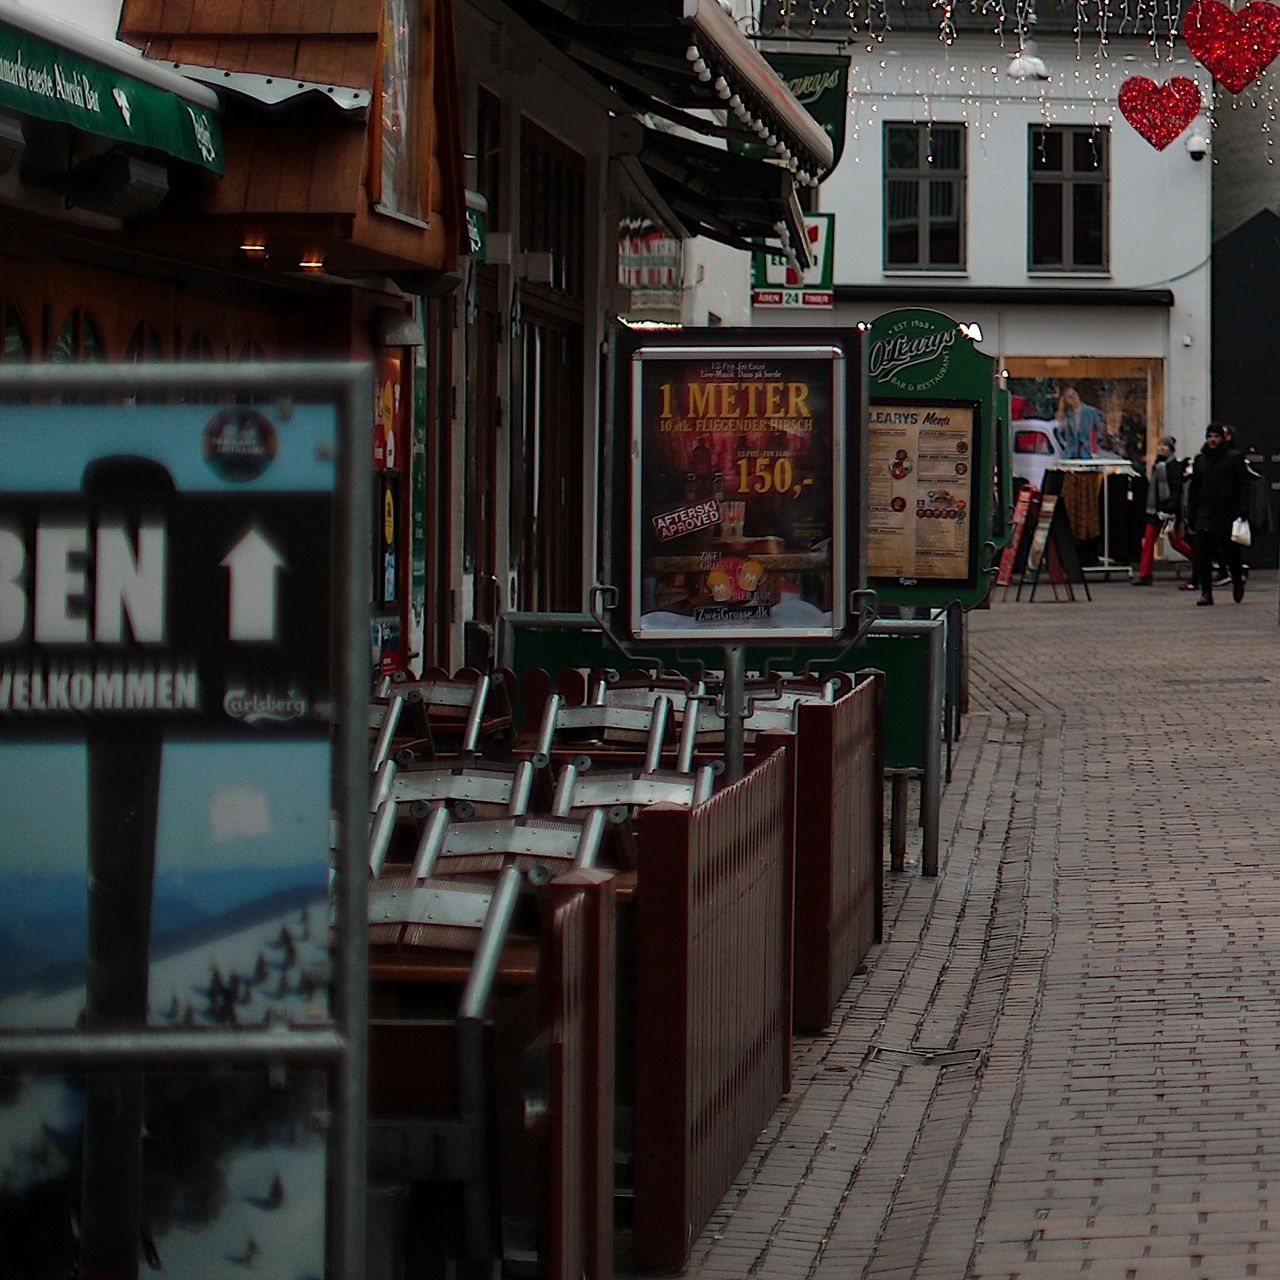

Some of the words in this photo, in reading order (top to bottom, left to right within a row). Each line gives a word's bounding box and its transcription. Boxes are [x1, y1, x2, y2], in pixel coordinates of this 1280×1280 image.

[785, 292, 799, 305] 24
[893, 321, 907, 332] EST
[891, 377, 906, 390] BAR
[916, 350, 951, 391] RESTAURANT
[659, 383, 673, 418] 1
[687, 382, 812, 418] METER
[659, 421, 673, 433] 10
[696, 420, 769, 433] FLIEGENDER
[770, 420, 813, 433] HIRSCH
[922, 411, 951, 427] Menu
[657, 501, 717, 529] AFTERSKI
[661, 511, 719, 539] APROVED
[698, 605, 769, 621] ZweiGrosse.dk
[223, 688, 306, 725] Carlsberg
